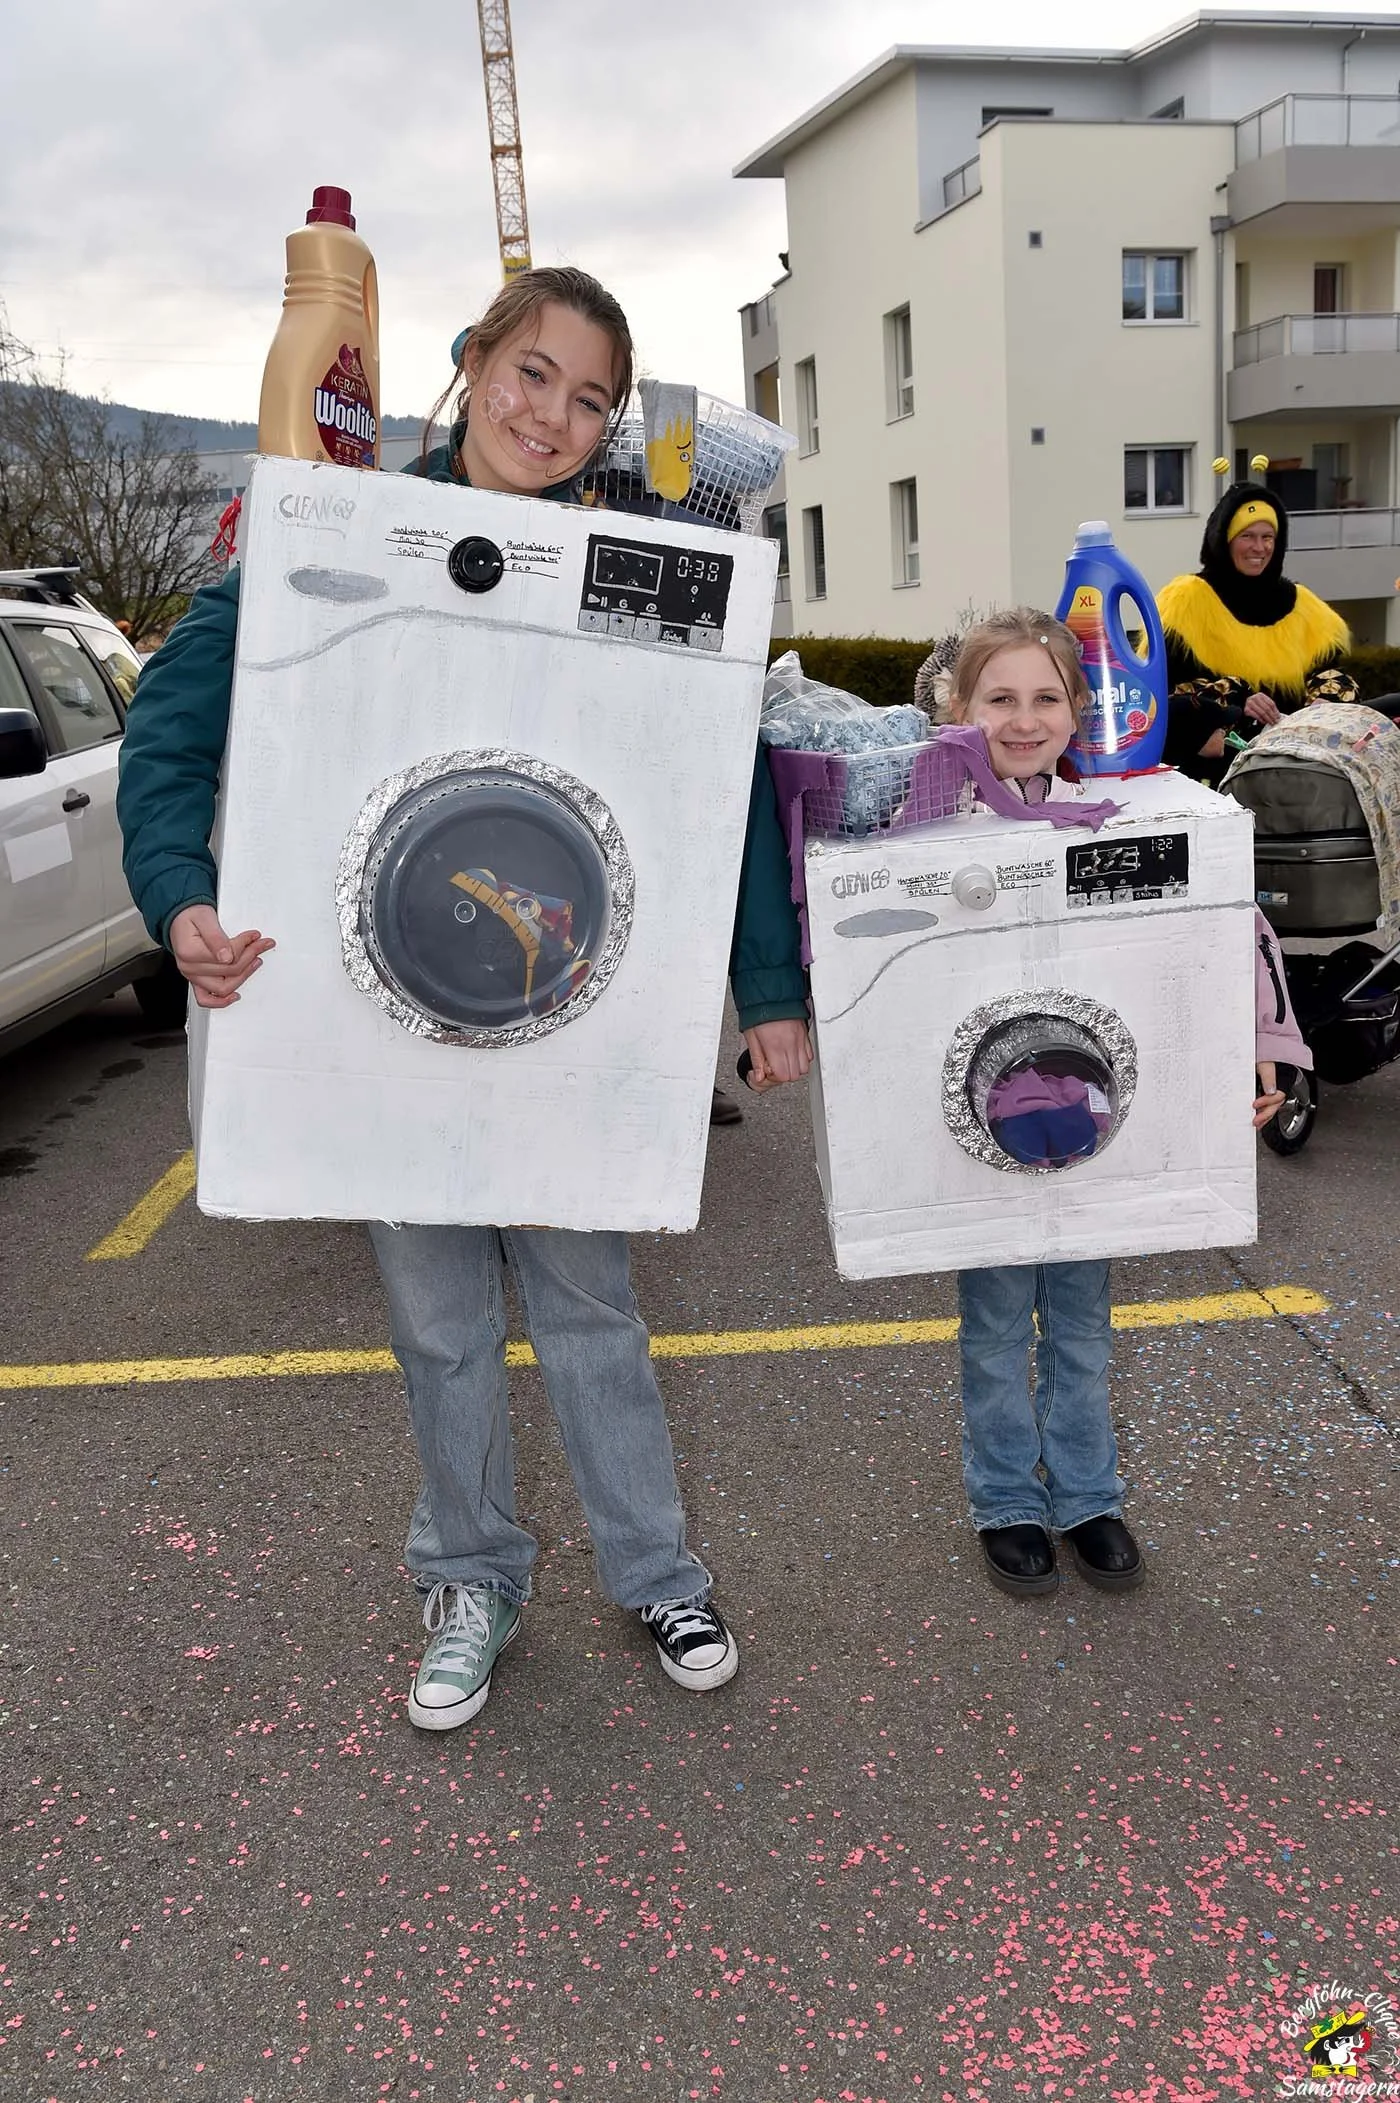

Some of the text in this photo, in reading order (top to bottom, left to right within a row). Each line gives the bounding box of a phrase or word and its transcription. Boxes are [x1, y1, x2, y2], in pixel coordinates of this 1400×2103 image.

[331, 374, 369, 399] KERATIN
[315, 388, 377, 444] Woolite
[278, 494, 333, 521] CLEAN
[511, 563, 530, 572] Eco
[1079, 595, 1096, 609] XL
